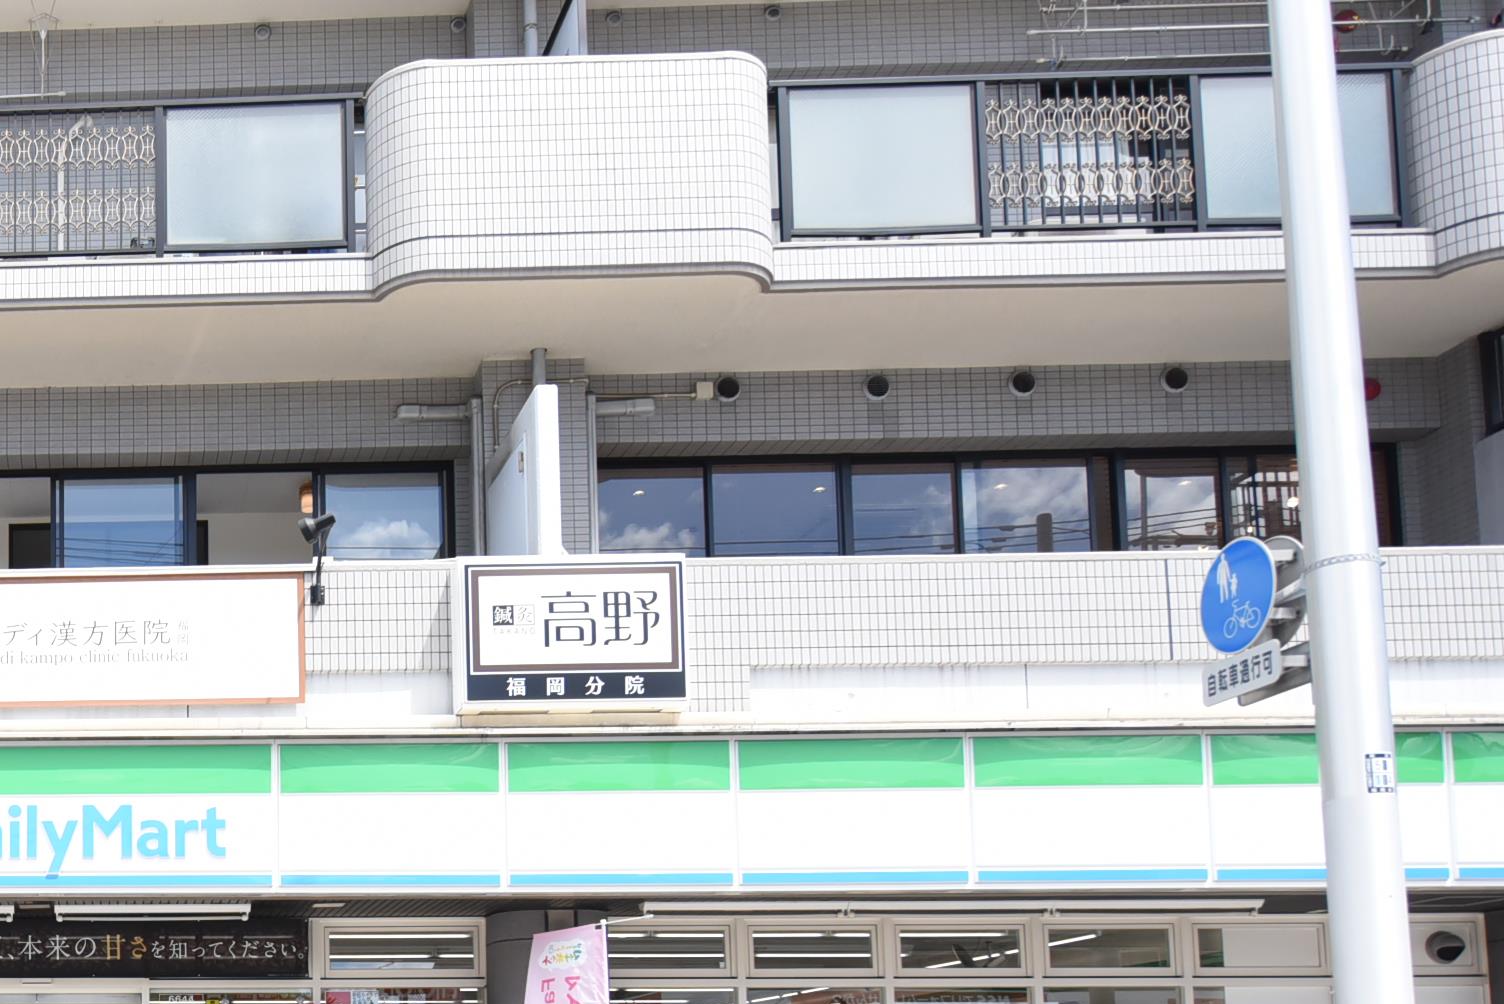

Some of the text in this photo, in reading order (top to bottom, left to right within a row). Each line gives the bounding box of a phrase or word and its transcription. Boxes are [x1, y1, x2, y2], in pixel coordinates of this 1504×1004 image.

[541, 591, 661, 647] 高野
[20, 650, 73, 668] kampo
[80, 649, 121, 664] clinic
[127, 648, 189, 663] fukuoka
[1207, 650, 1273, 698] 自転車通行可
[506, 675, 645, 697] 福岡分院
